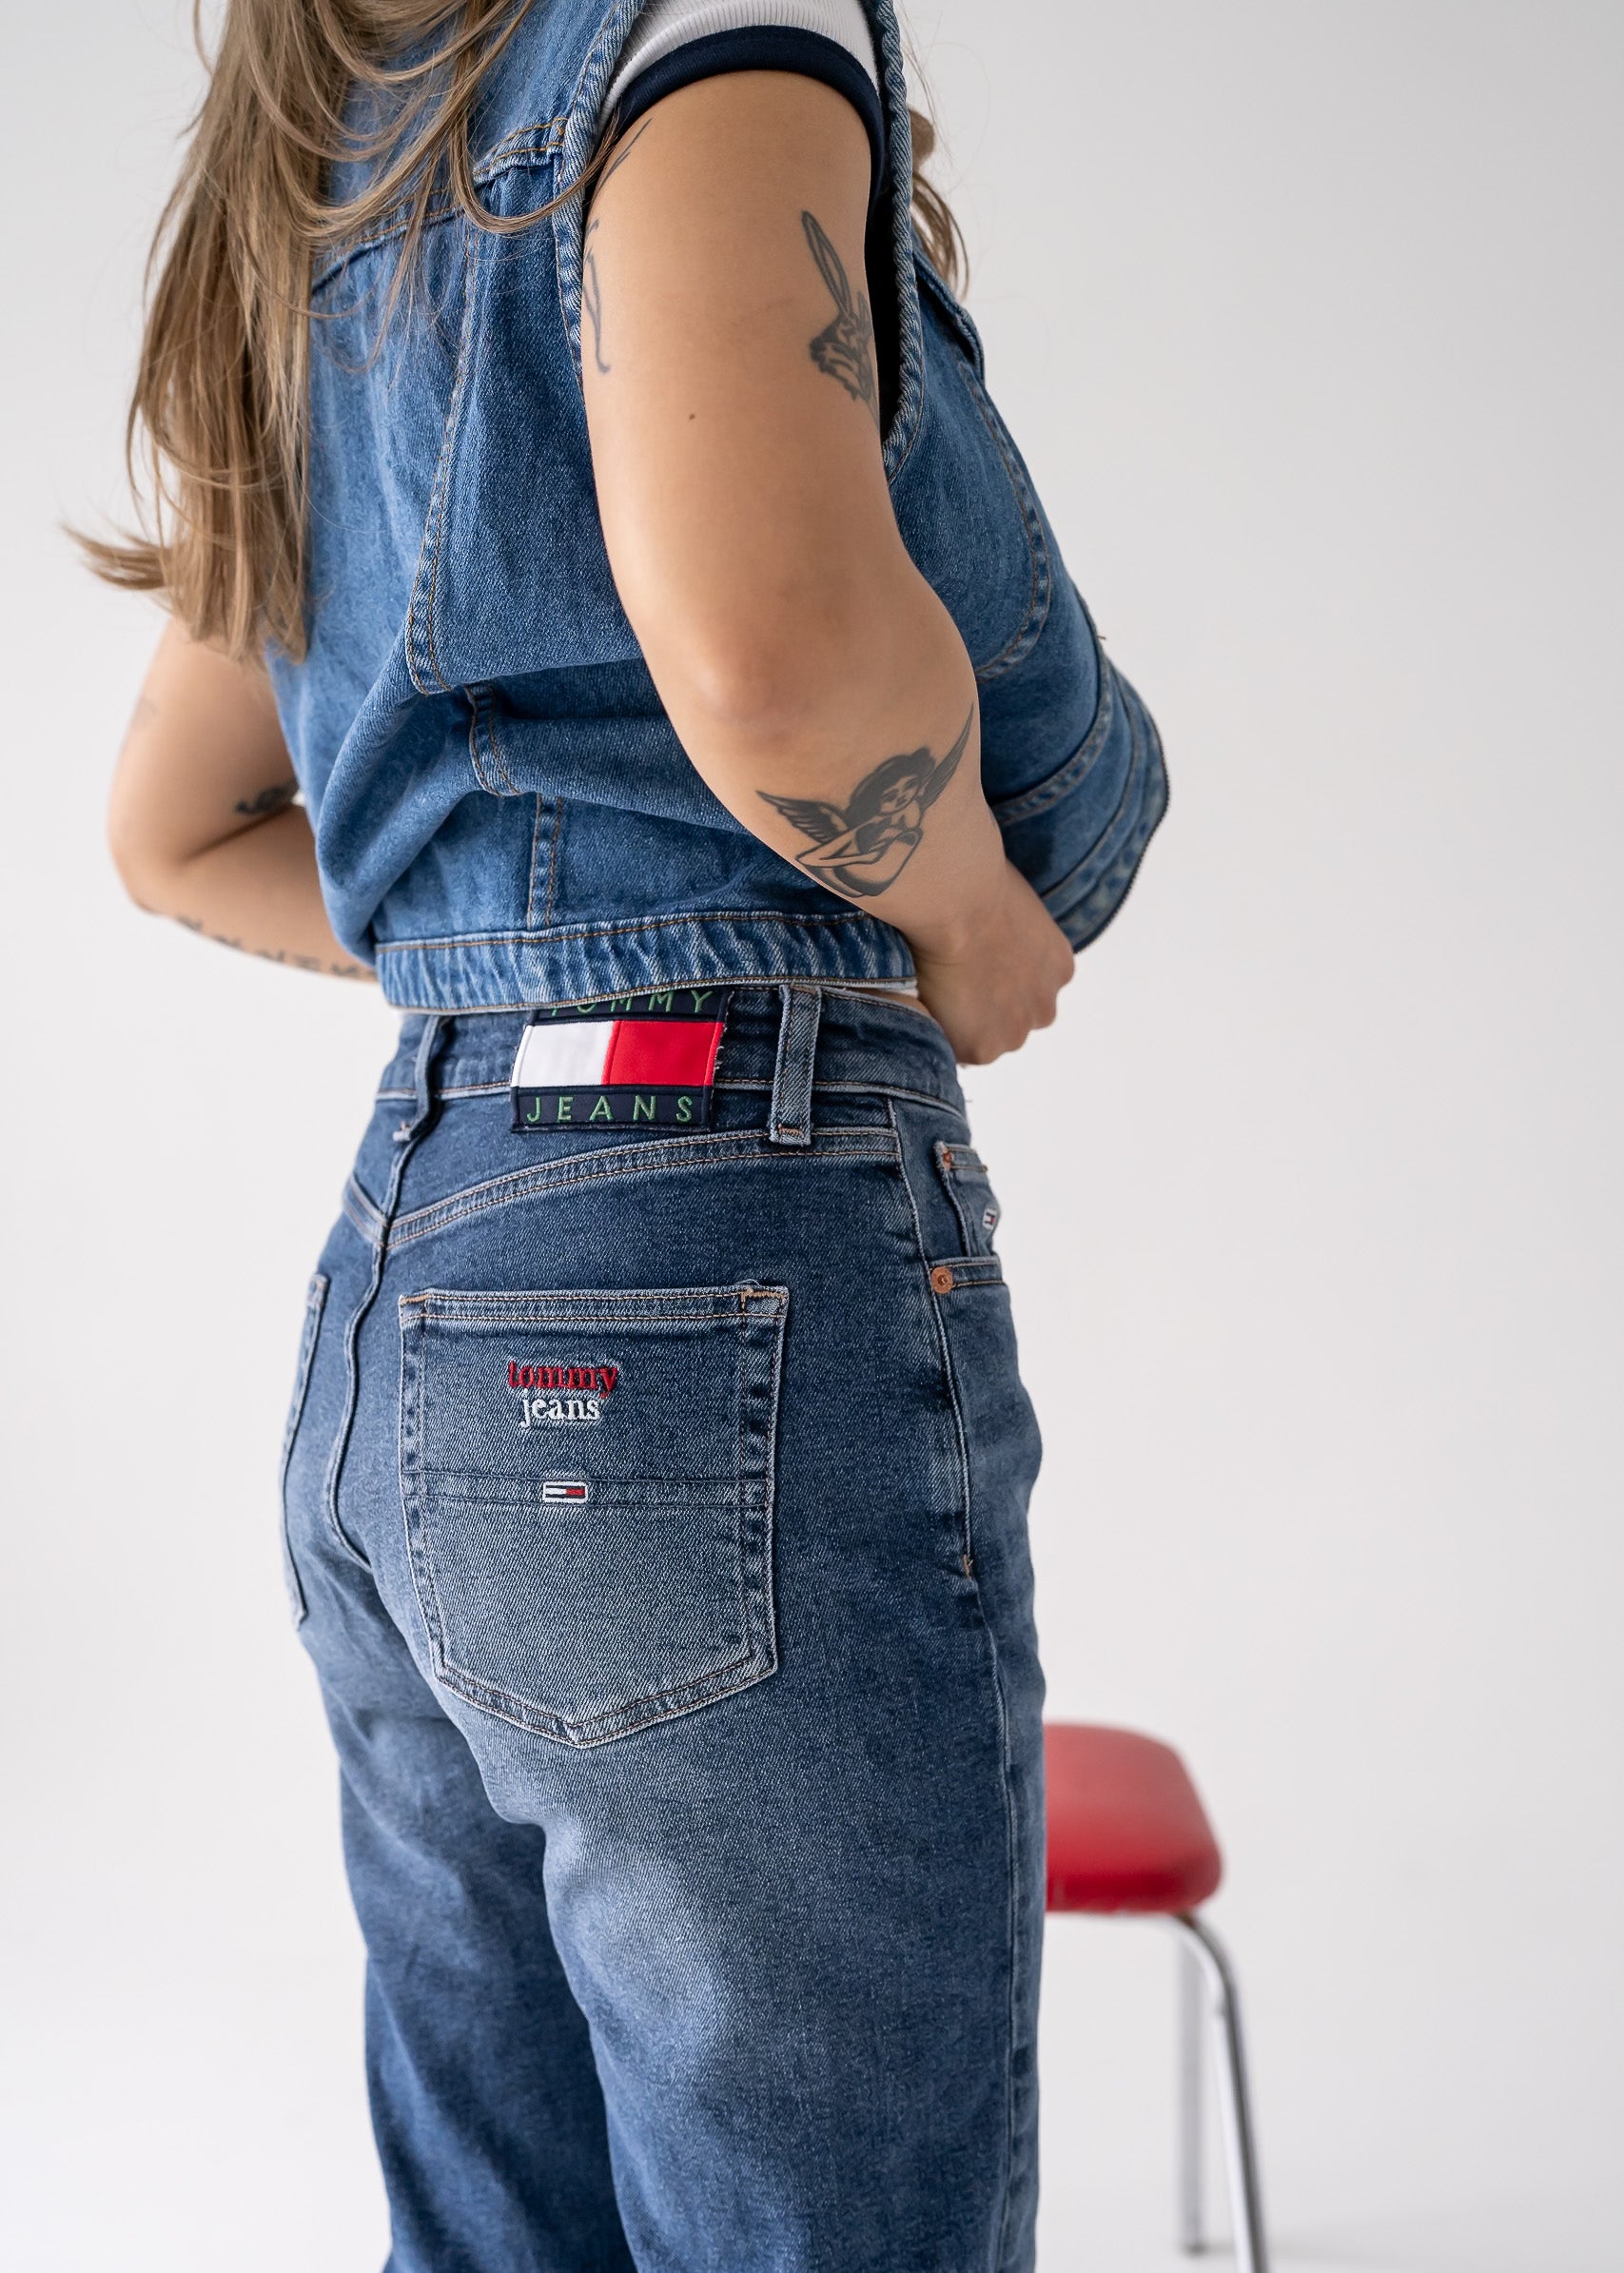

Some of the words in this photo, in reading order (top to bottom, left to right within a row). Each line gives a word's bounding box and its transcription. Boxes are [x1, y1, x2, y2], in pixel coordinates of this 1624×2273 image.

[551, 989, 713, 1017] MMY
[526, 1095, 694, 1123] JEANS
[507, 1361, 618, 1400] tommy
[519, 1388, 601, 1427] jeans
